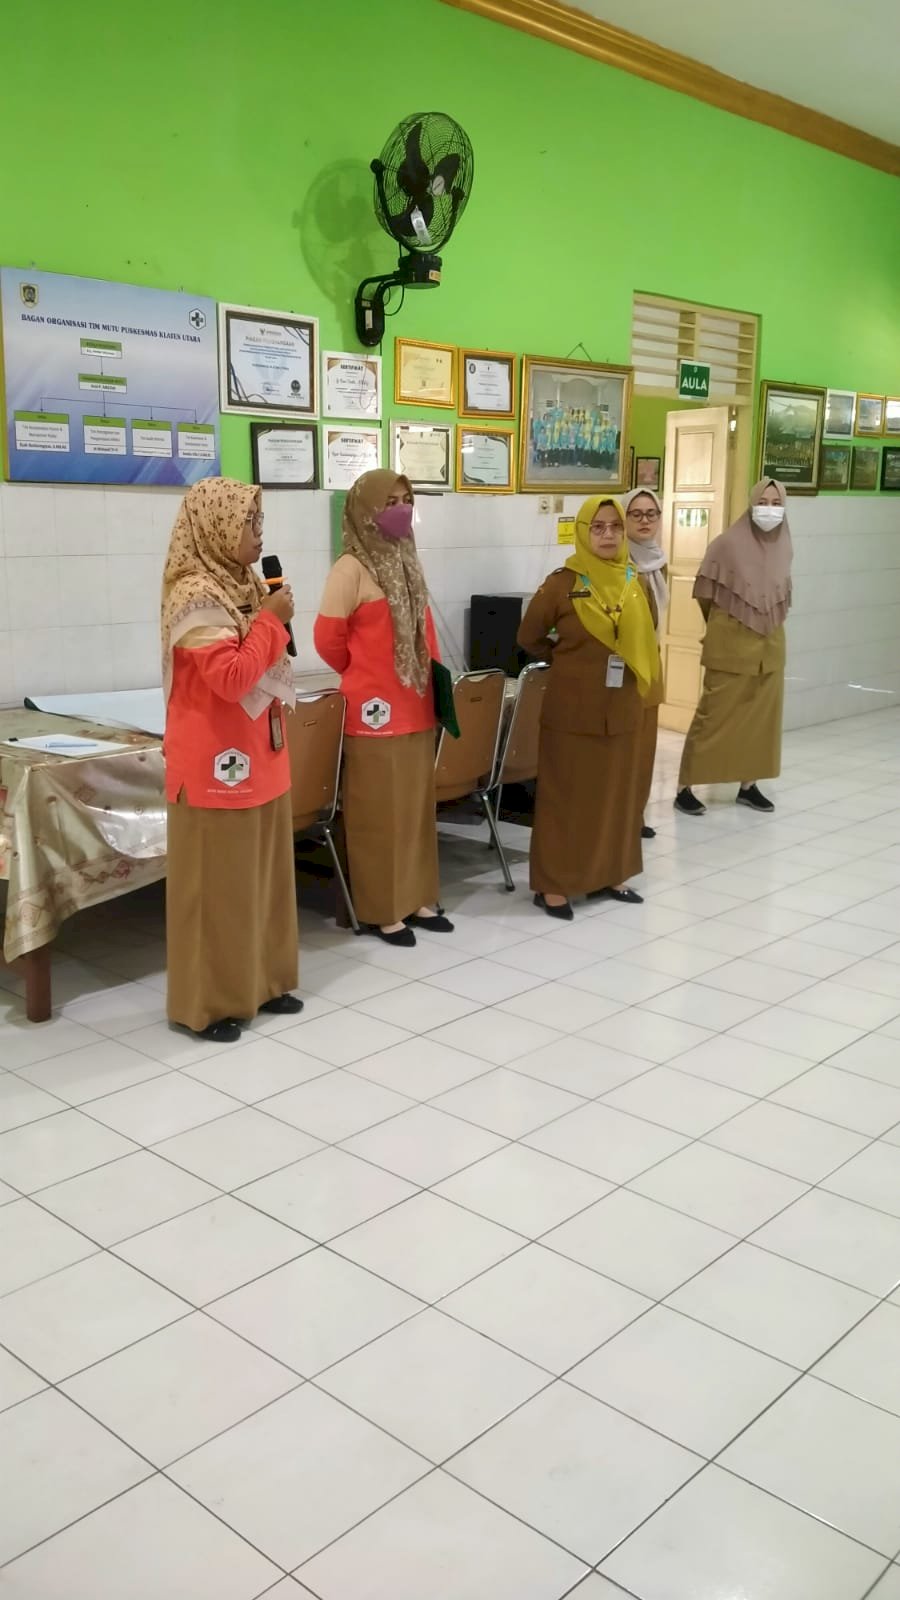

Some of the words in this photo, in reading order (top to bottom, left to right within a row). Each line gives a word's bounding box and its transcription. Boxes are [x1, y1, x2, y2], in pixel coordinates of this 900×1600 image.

[21, 313, 45, 323] BAGAN
[46, 317, 87, 329] ORGANISASI
[88, 322, 101, 330] TIM
[101, 323, 120, 332] MUTU
[121, 326, 158, 337] PUSKESMAS
[182, 334, 201, 343] UTARA
[681, 376, 708, 391] AULA
